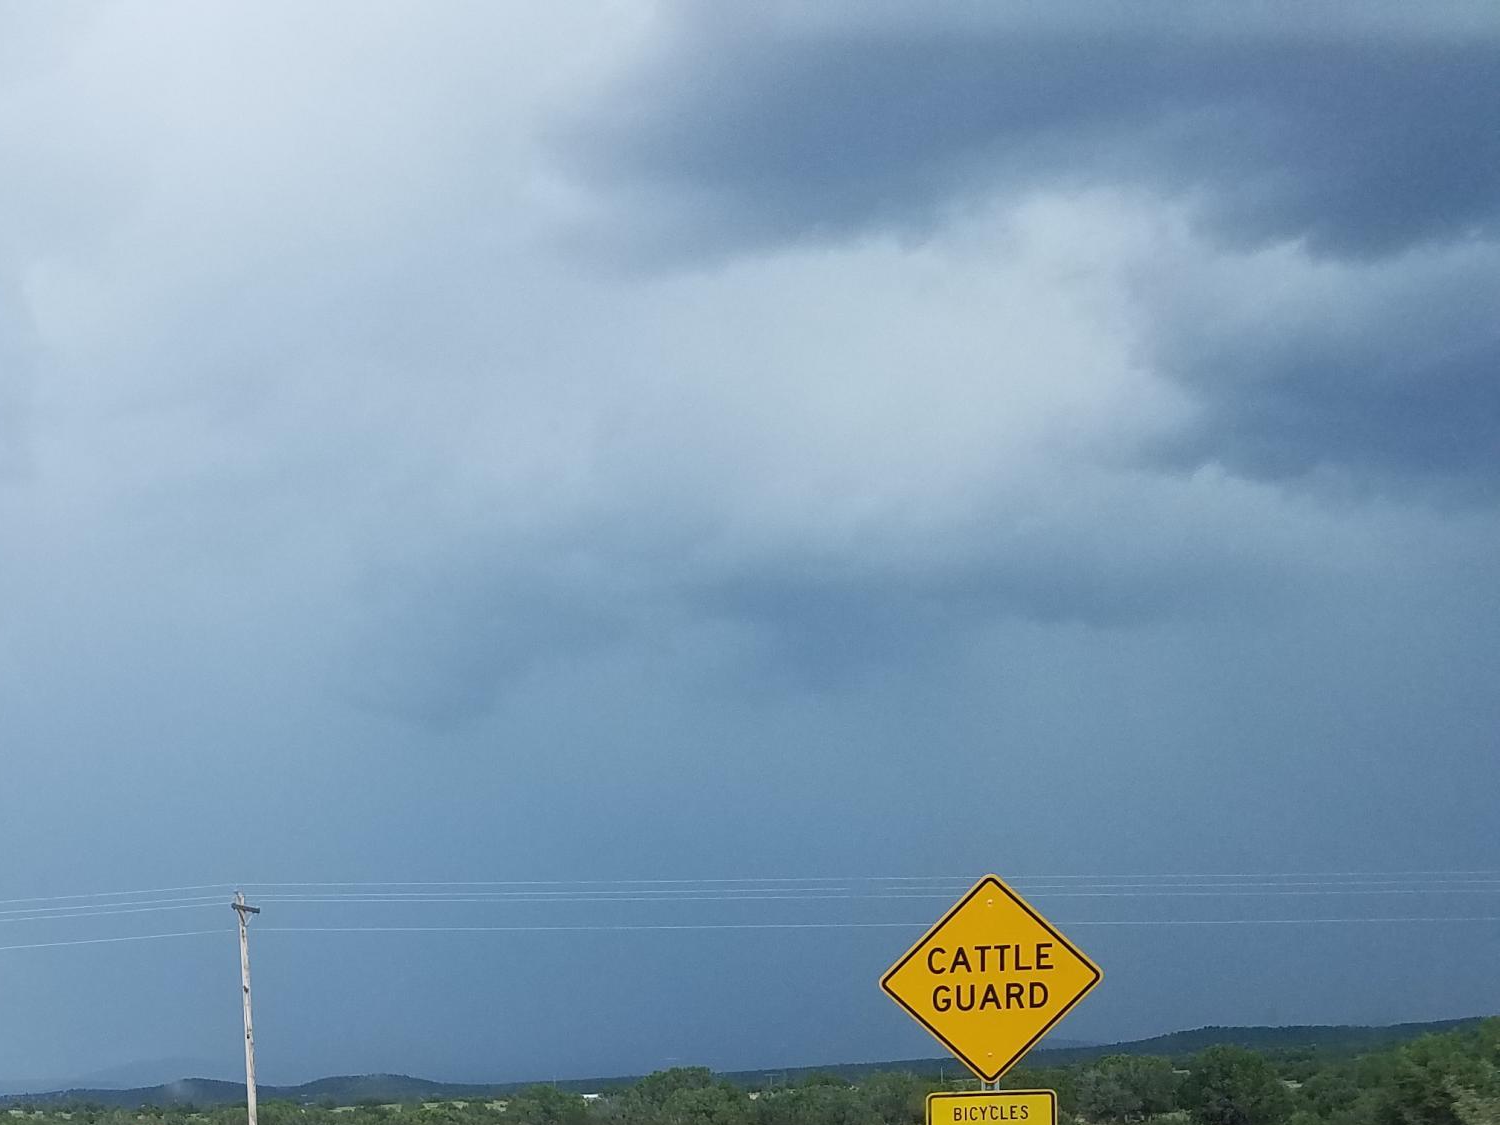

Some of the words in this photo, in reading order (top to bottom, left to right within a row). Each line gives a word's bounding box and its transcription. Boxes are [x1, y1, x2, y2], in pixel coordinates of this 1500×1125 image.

[927, 943, 1054, 974] CATTLE
[932, 982, 1049, 1012] GUARD
[953, 1105, 1029, 1121] BICYCLES
